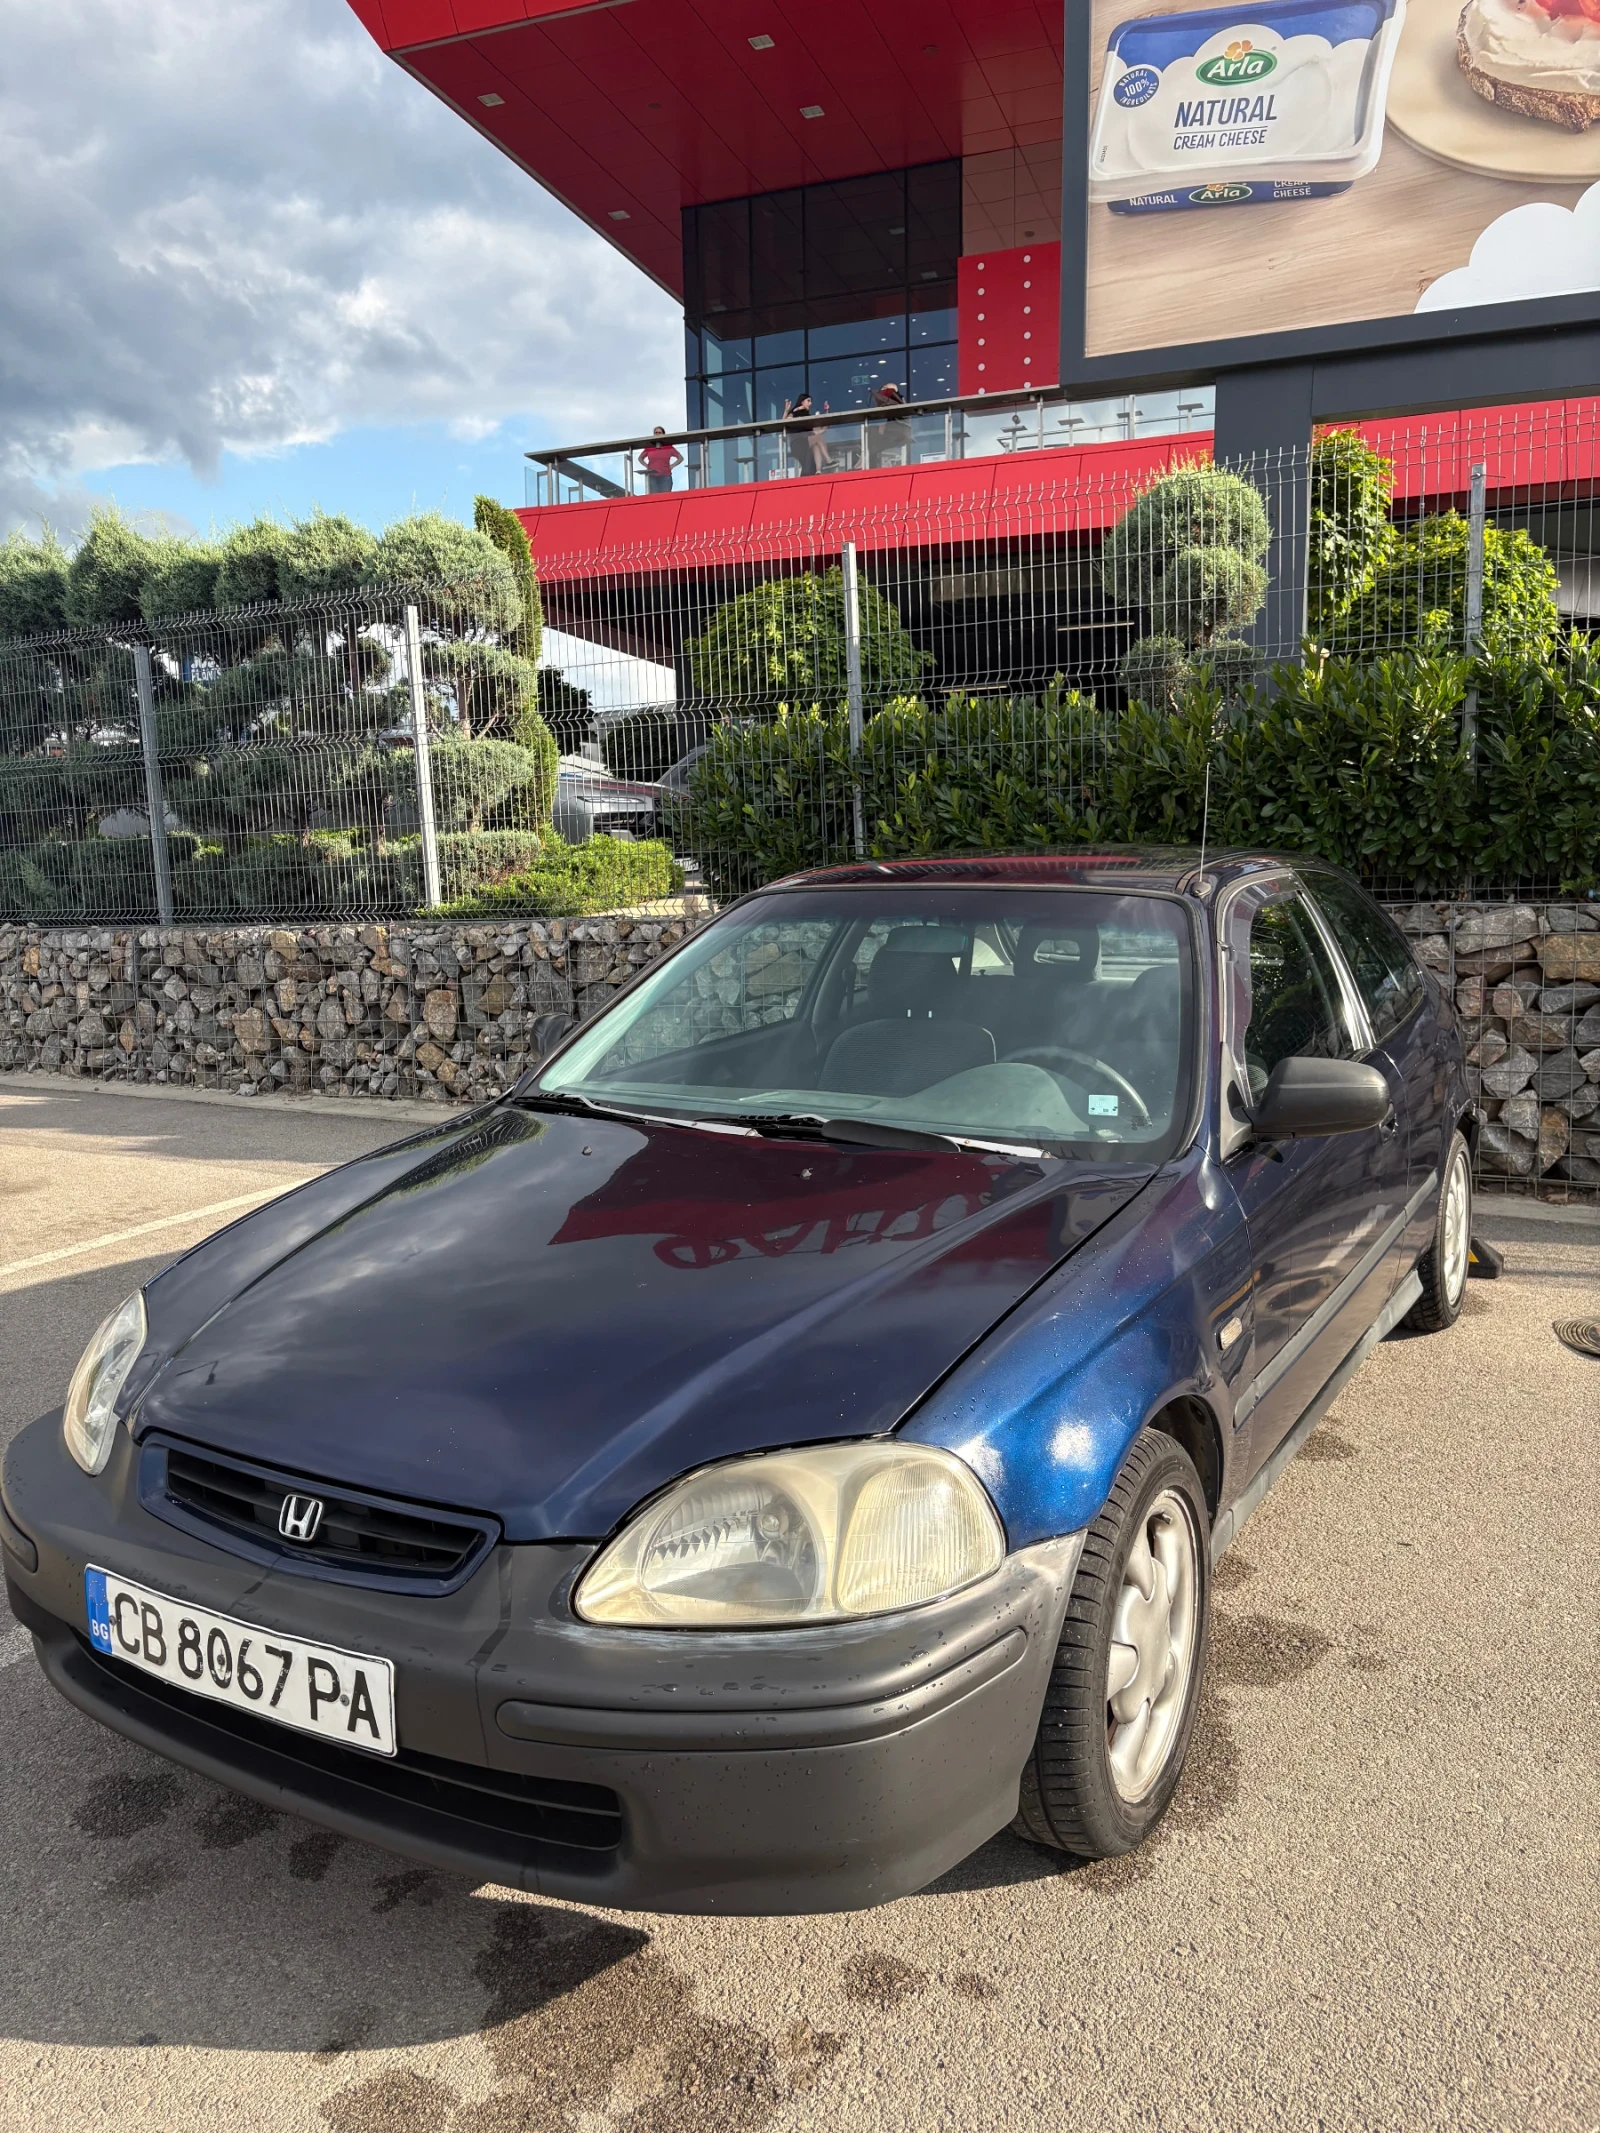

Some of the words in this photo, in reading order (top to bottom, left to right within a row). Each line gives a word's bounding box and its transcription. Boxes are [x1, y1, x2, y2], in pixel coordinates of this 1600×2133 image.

[1206, 56, 1264, 78] Arla
[1118, 70, 1148, 87] NATURAL
[1124, 78, 1150, 97] 100%
[1119, 82, 1158, 106] INGREDIENTS
[1174, 94, 1278, 128] NATURAL
[1173, 134, 1216, 150] CREAM
[1218, 129, 1268, 147] CHEESE
[1129, 194, 1179, 206] NATURAL
[1200, 188, 1240, 200] Arla
[1273, 187, 1312, 198] CHEESE
[91, 1618, 110, 1641] BG
[114, 1592, 168, 1667] CB
[177, 1616, 293, 1708] 8067
[306, 1655, 382, 1740] PA
